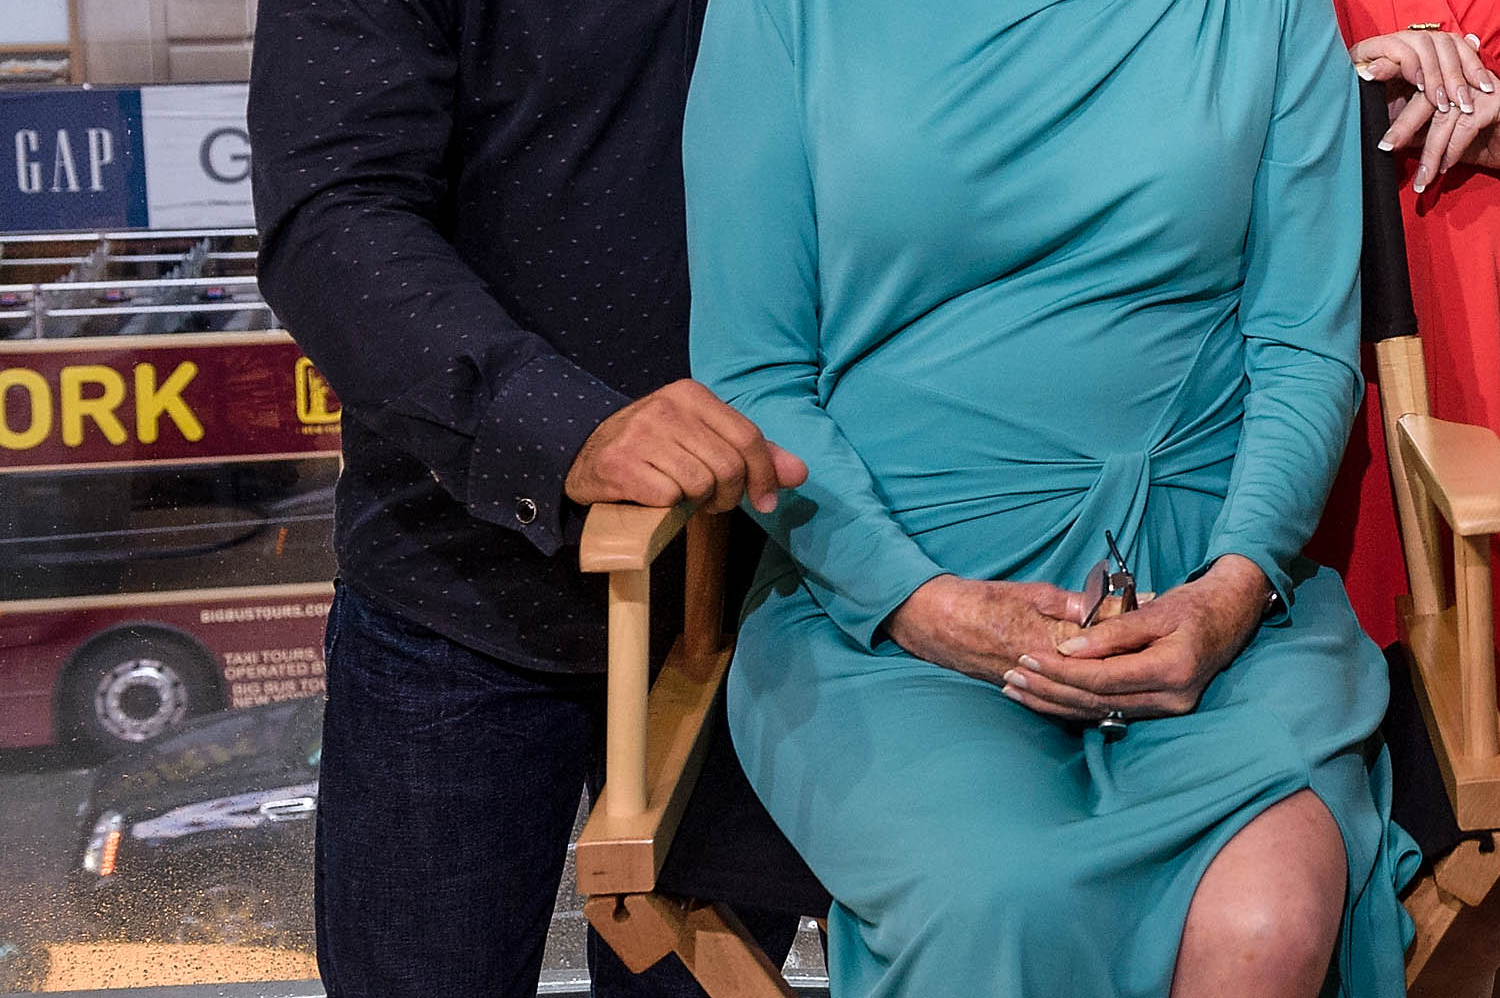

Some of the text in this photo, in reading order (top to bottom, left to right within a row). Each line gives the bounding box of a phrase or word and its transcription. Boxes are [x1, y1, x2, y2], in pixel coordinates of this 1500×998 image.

[15, 128, 114, 194] GAP
[0, 361, 205, 451] ORK
[224, 661, 309, 680] OPERATED
[232, 682, 261, 696] BIG
[264, 679, 298, 695] BUS
